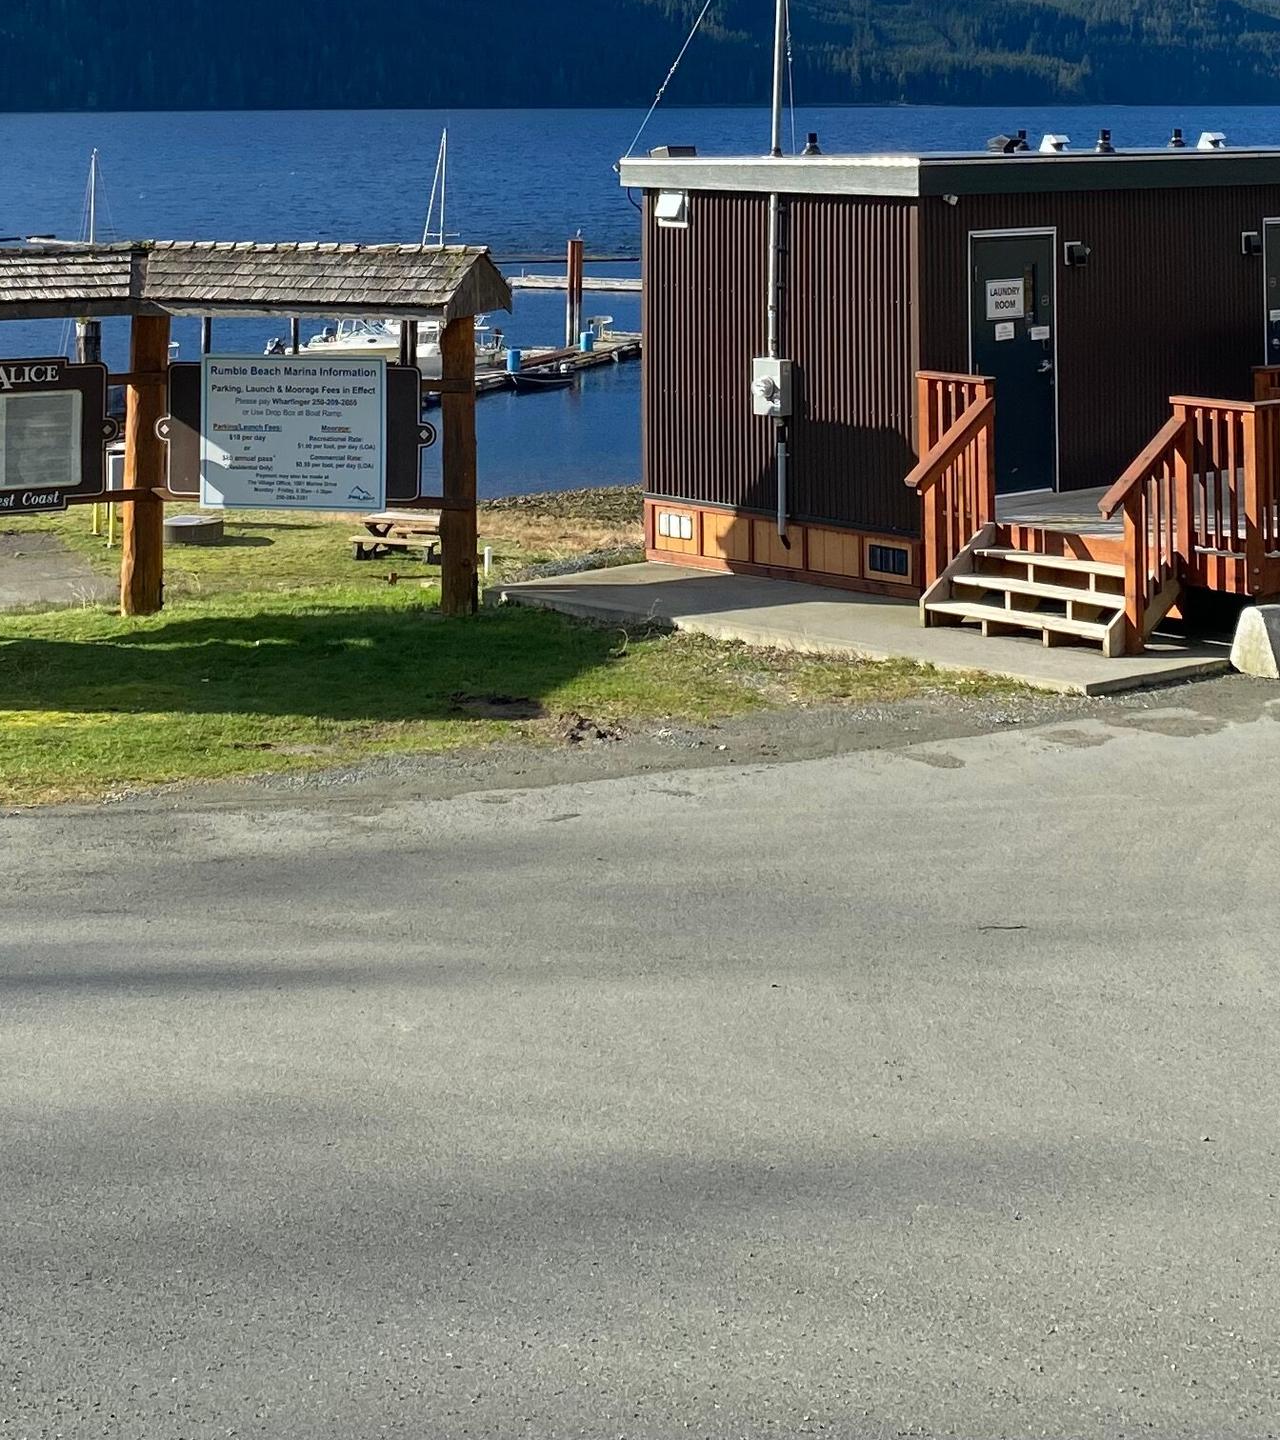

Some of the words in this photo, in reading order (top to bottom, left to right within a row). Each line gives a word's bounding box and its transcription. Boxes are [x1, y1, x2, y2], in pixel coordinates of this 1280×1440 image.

[990, 287, 1020, 296] LAUNDRY
[995, 300, 1015, 309] ROOM
[210, 366, 248, 376] Rumble
[250, 366, 281, 376] Beach
[284, 367, 317, 377] Marina
[320, 367, 377, 378] Information
[245, 385, 275, 393] Launch
[285, 386, 319, 395] Moorage
[322, 386, 340, 394] Fees
[342, 386, 350, 394] in
[352, 387, 376, 395] Effect
[259, 399, 270, 407] pay
[272, 398, 310, 407] Wharfinger
[254, 434, 266, 442] day
[22, 491, 60, 505] Coast
